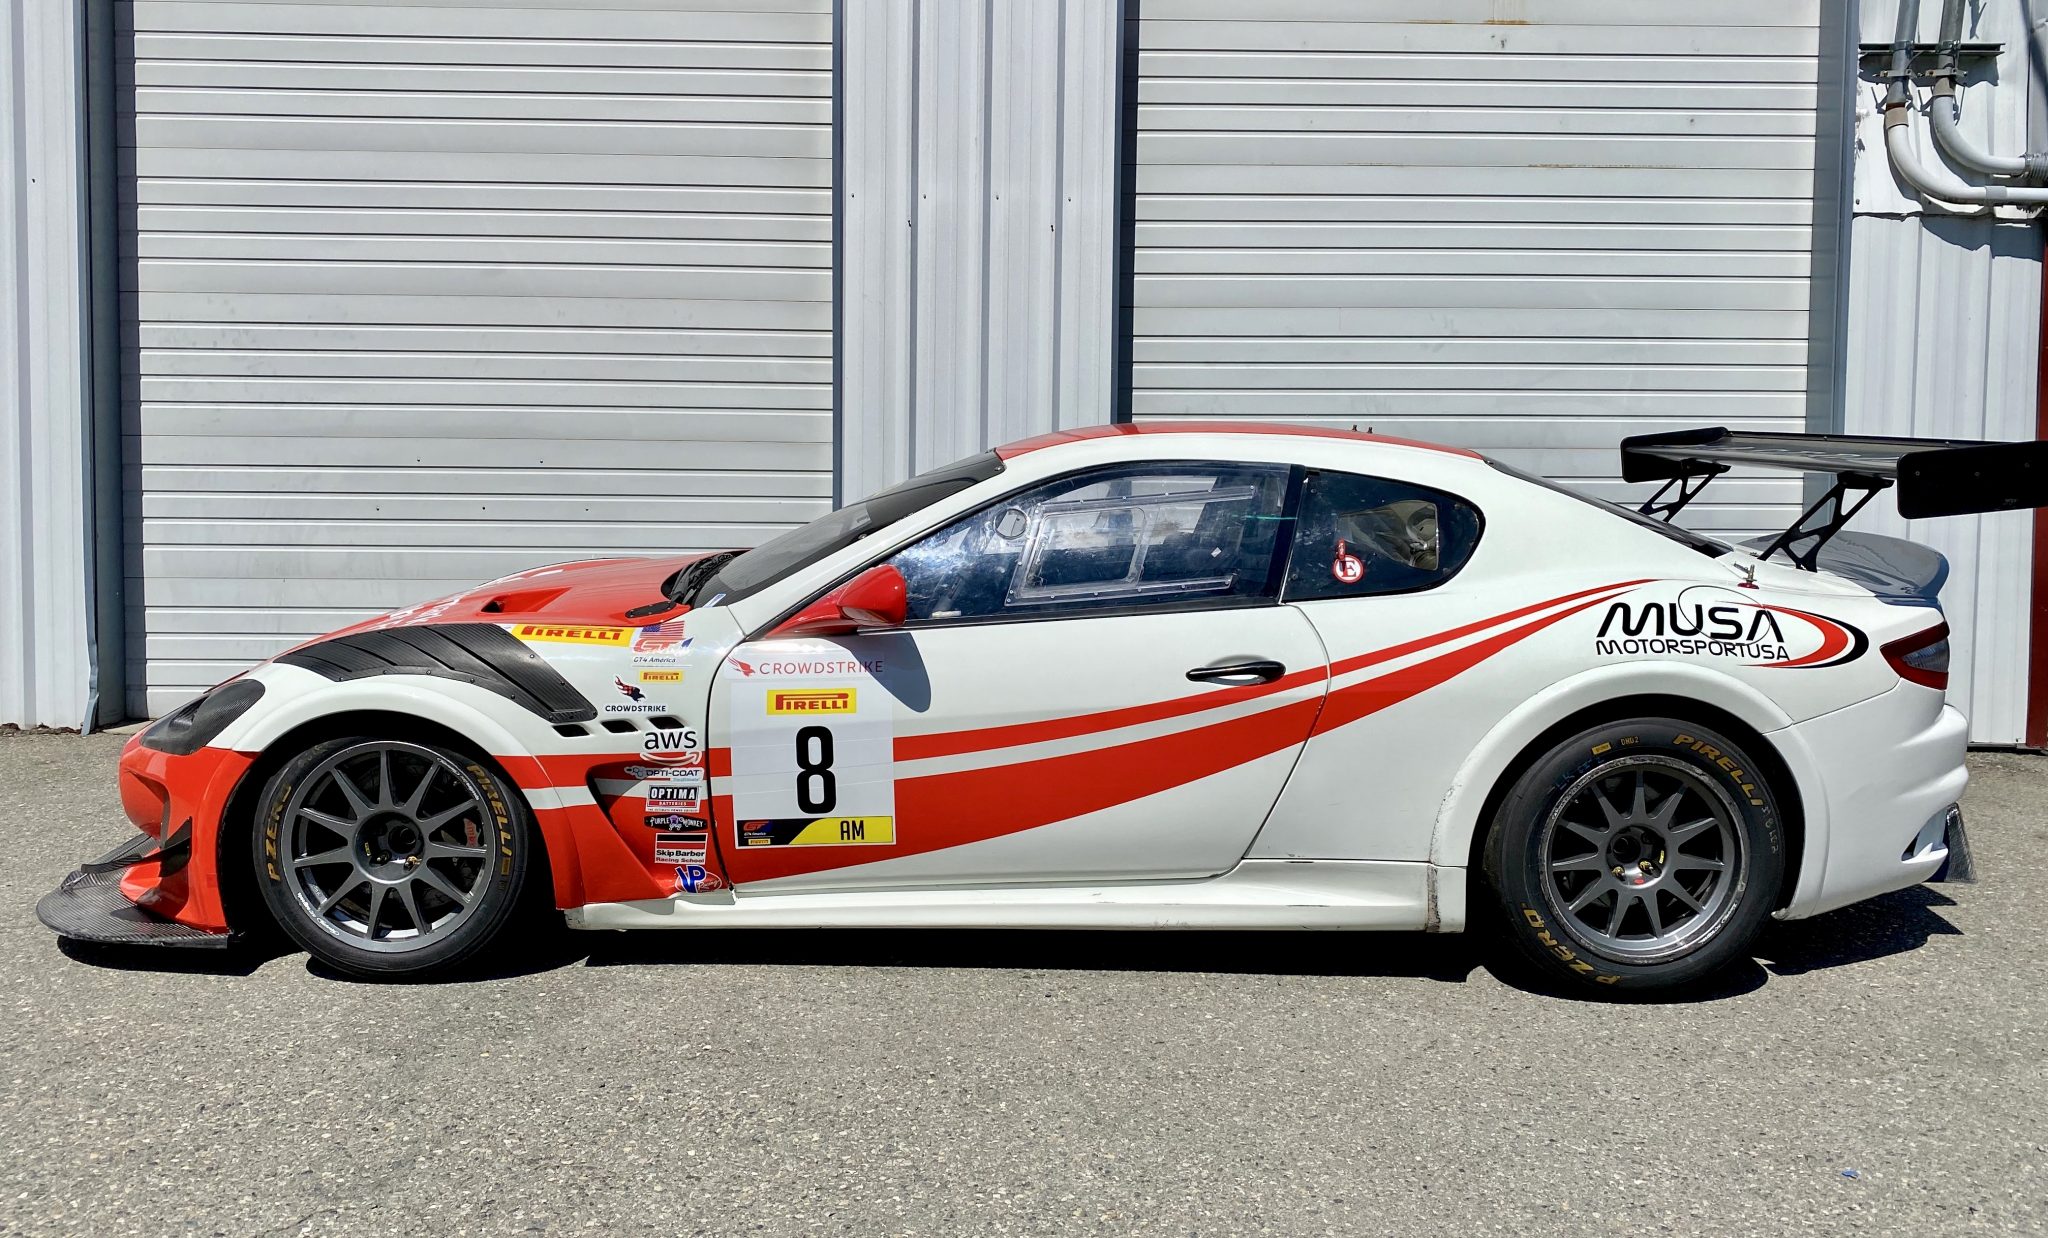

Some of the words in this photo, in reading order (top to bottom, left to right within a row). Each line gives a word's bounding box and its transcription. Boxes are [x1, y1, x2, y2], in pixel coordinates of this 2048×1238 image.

[1597, 602, 1784, 643] MUSA
[520, 625, 624, 640] PIRELLI
[1596, 639, 1790, 661] MOTORSPORTUSA
[643, 672, 679, 680] PIRELLI
[760, 660, 884, 674] CROWDSTRIKE
[775, 692, 849, 710] PIRELLI
[644, 731, 697, 750] aws
[646, 769, 700, 777] OPTI-COAT
[796, 725, 837, 814] 8
[1673, 734, 1764, 806] PIRELLI
[650, 788, 696, 800] OPTIMA
[466, 764, 512, 857] PIRELLI
[650, 817, 670, 827] PURPLE
[840, 820, 865, 841] AM
[675, 865, 707, 893] VP
